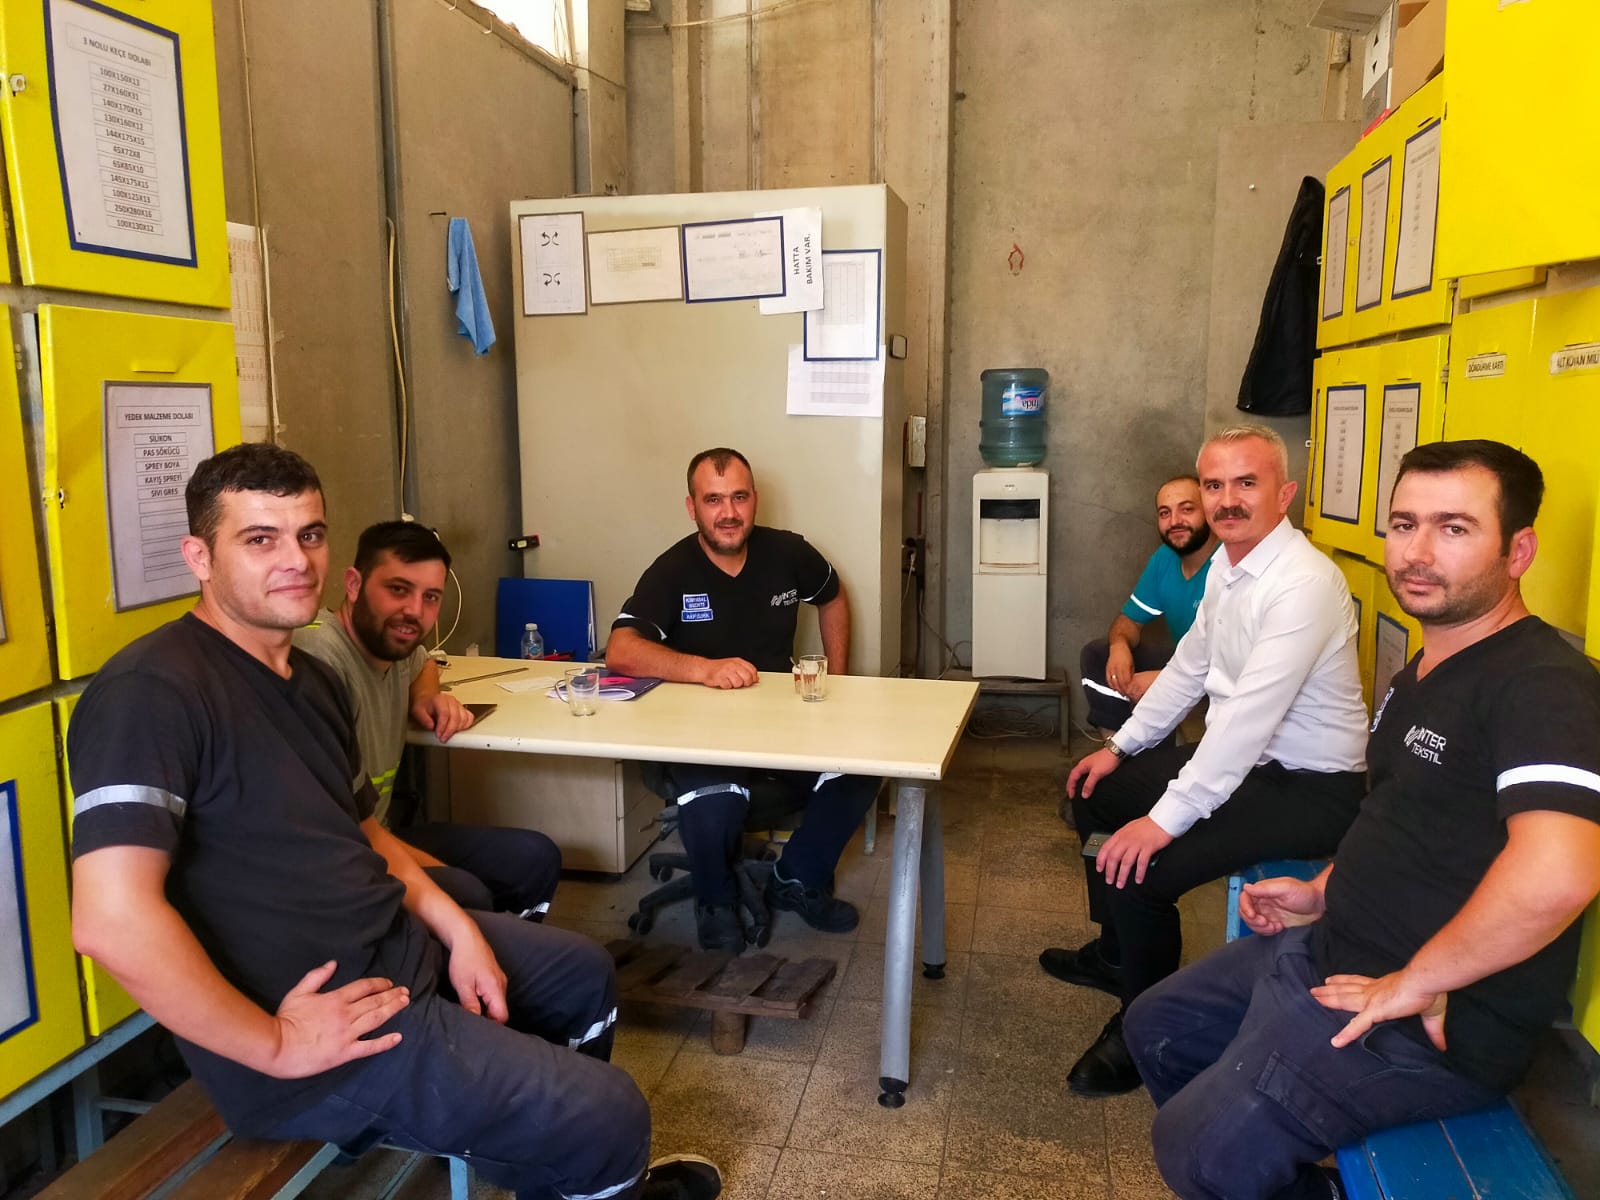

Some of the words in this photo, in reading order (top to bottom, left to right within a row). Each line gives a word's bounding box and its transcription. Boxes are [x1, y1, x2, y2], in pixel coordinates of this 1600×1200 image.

[88, 39, 109, 52] NOLU
[127, 52, 151, 66] DOLABI
[792, 245, 800, 275] HATTA
[804, 256, 813, 285] BAKIM
[124, 413, 142, 421] YEDEK
[143, 412, 172, 420] MALZEME
[172, 412, 194, 420] DOLABI
[143, 449, 155, 457] PAS
[156, 446, 181, 456] SÖKÜCÜ
[145, 462, 163, 470] SPREY
[164, 461, 181, 469] BOYA
[144, 476, 162, 485] KAYIŞ
[163, 488, 178, 496] GRES
